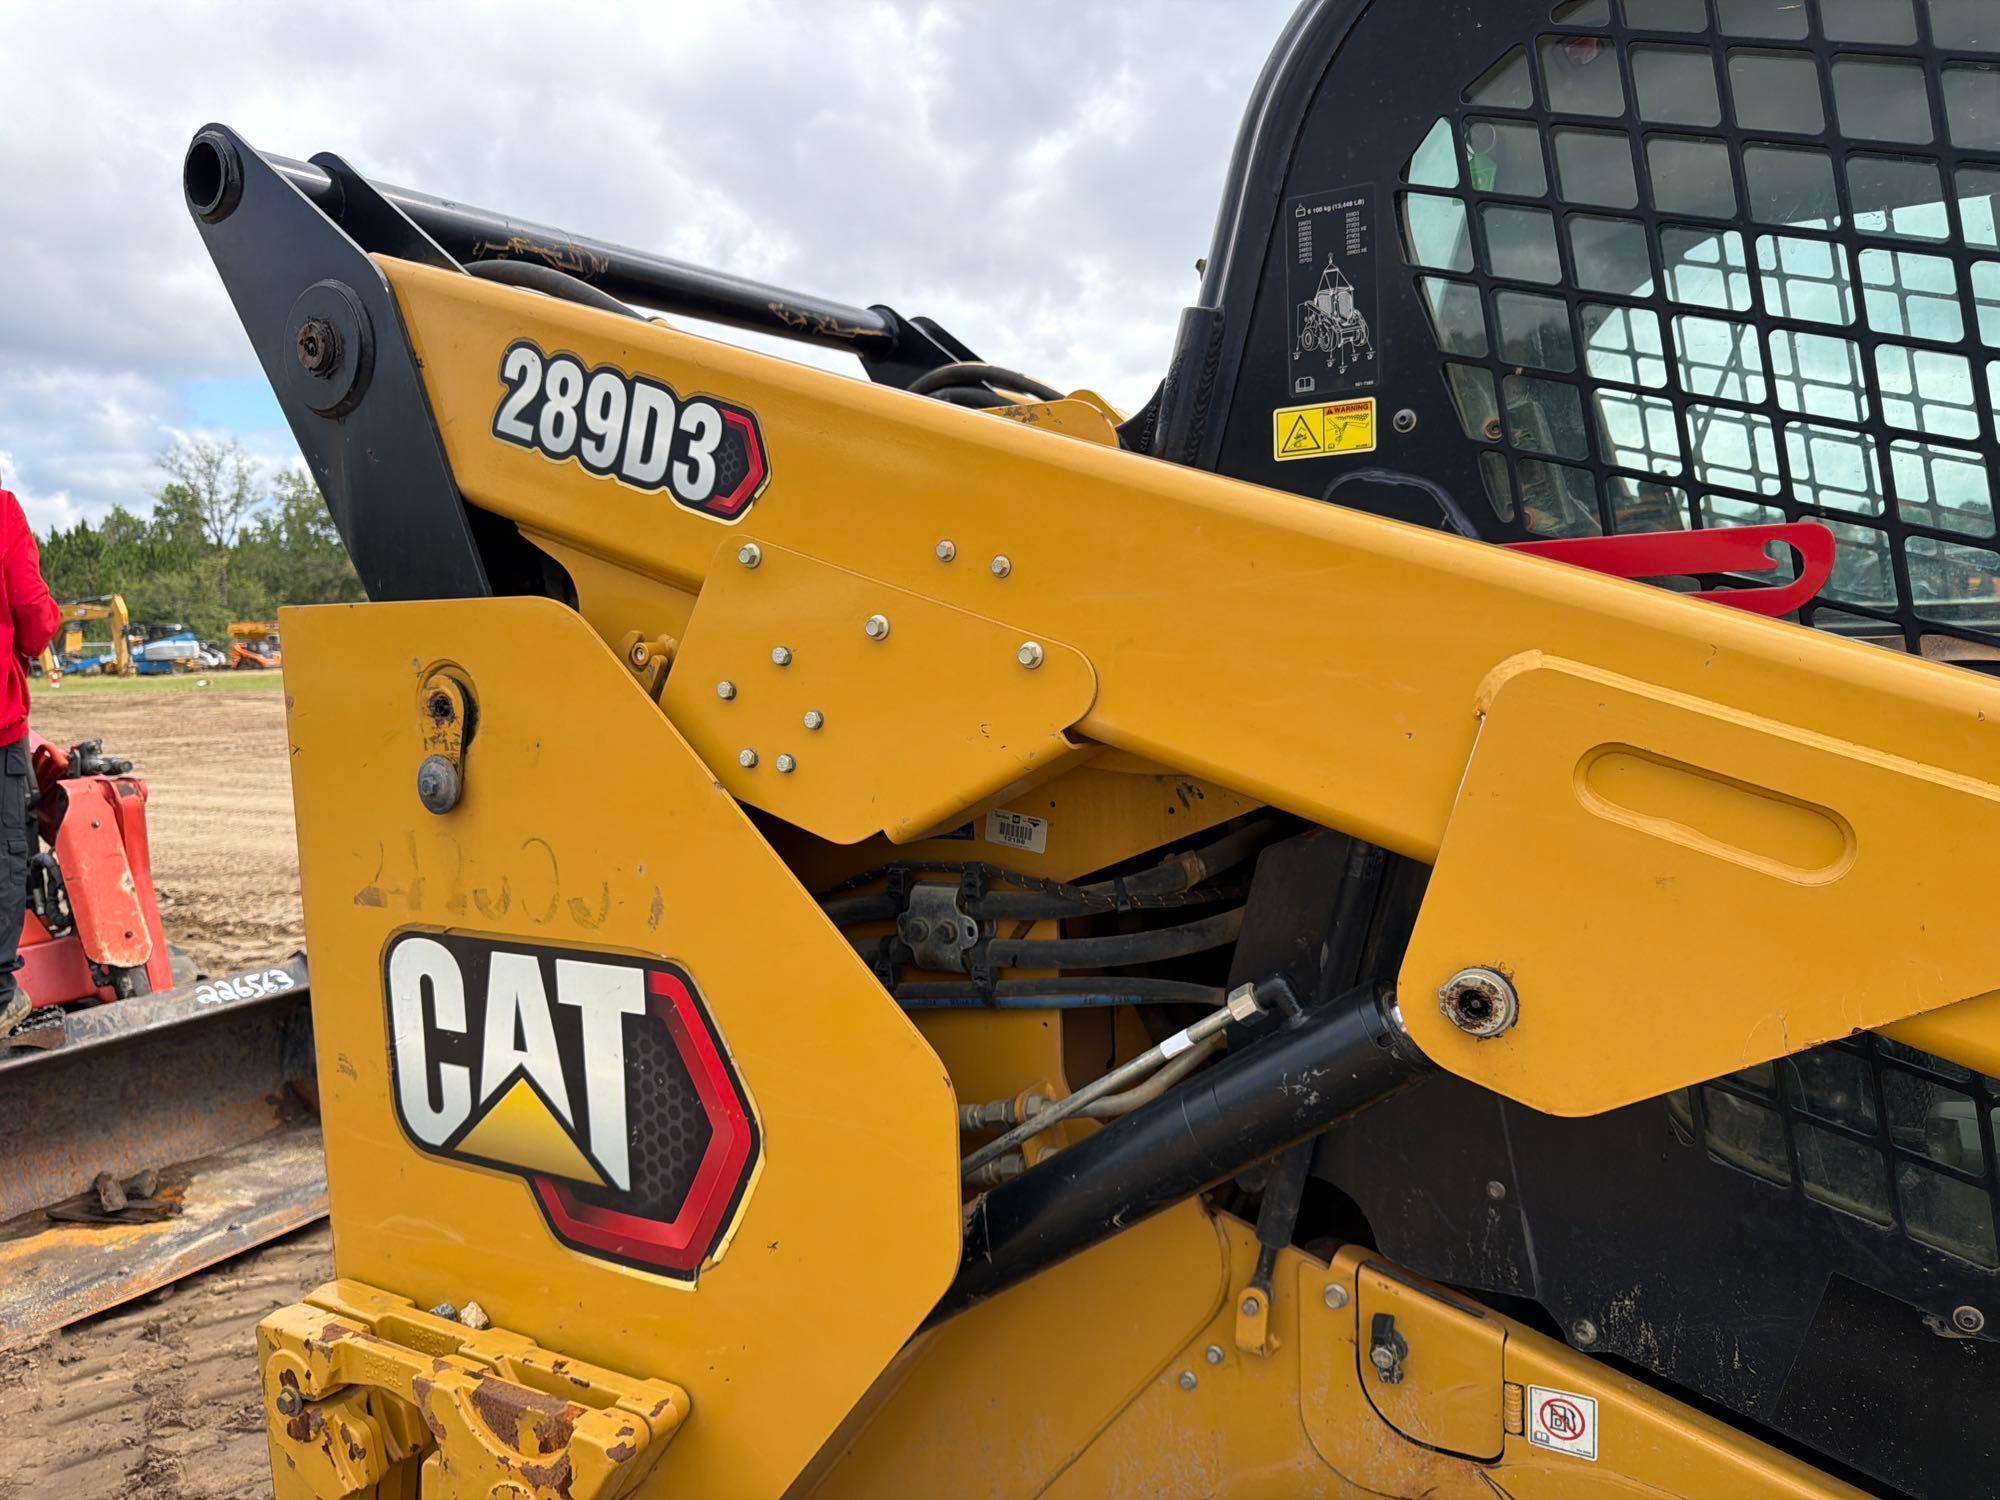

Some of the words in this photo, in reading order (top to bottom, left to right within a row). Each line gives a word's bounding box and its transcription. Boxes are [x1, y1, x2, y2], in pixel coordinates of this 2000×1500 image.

[497, 347, 723, 501] 289D3
[1334, 403, 1369, 413] WARNING
[195, 969, 295, 1004] 226563
[389, 937, 646, 1192] CAT
